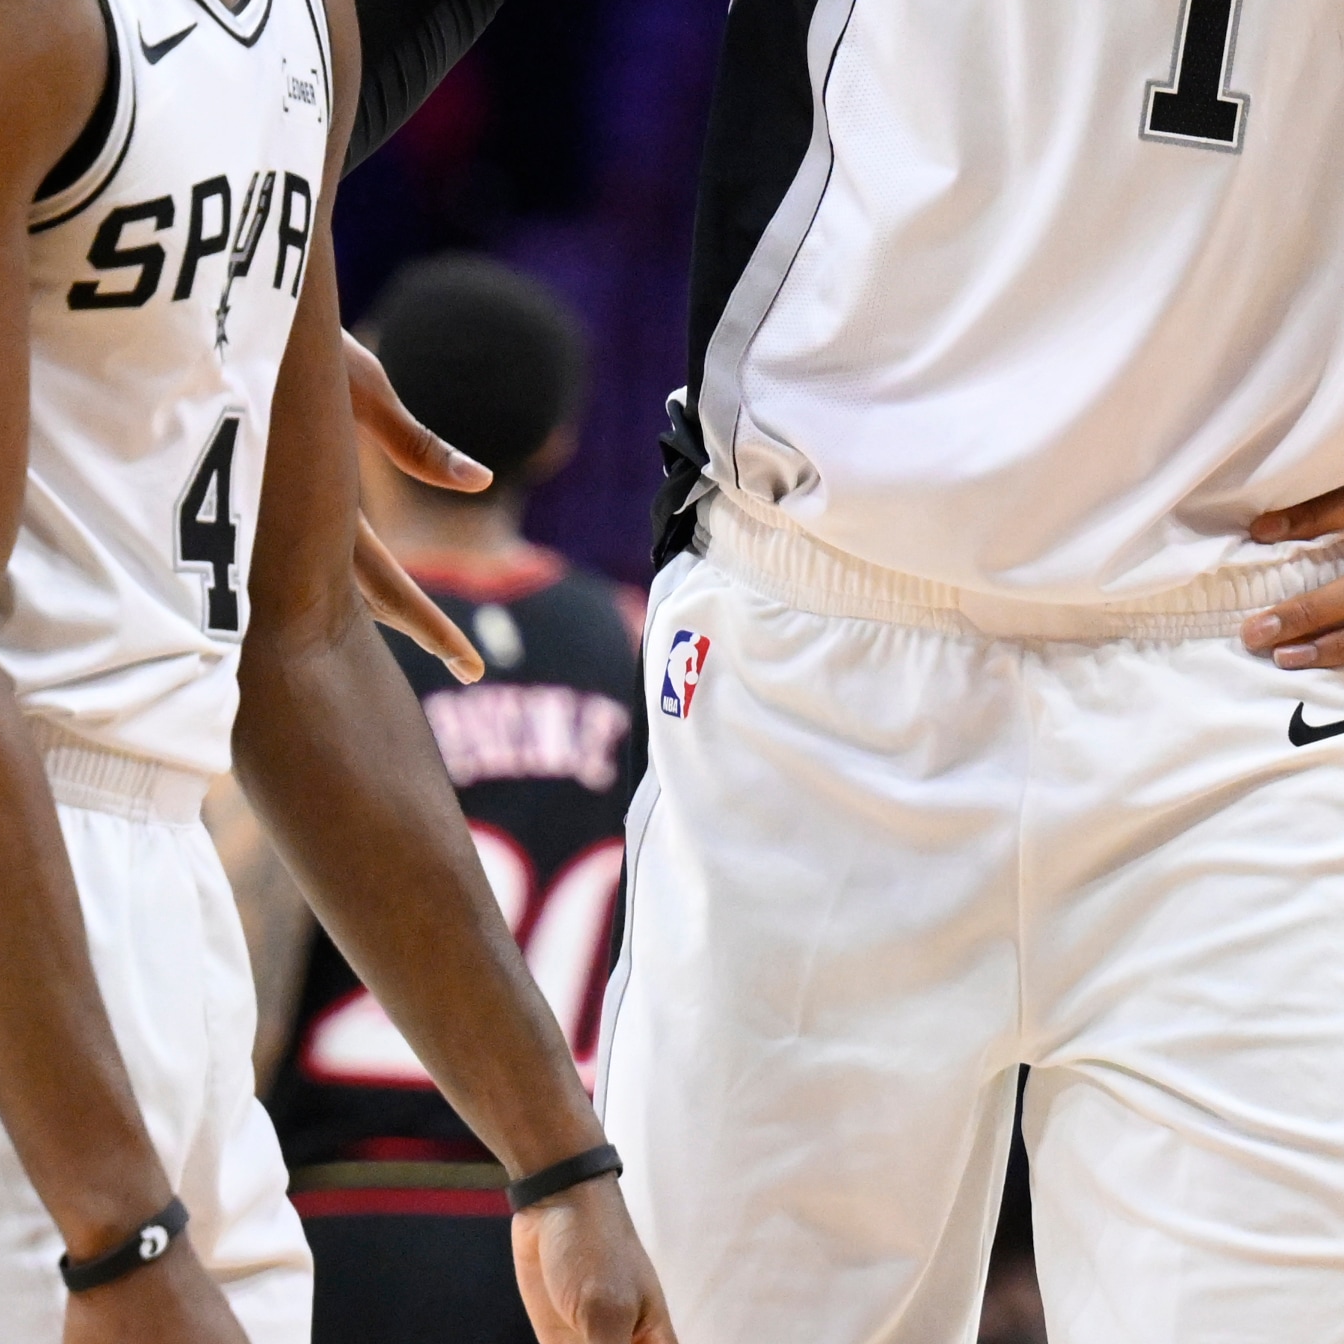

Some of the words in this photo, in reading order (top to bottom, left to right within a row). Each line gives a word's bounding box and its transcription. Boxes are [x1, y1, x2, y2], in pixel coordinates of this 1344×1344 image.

[66, 170, 313, 350] SPUR
[172, 405, 246, 644] 4
[662, 695, 679, 715] NBA
